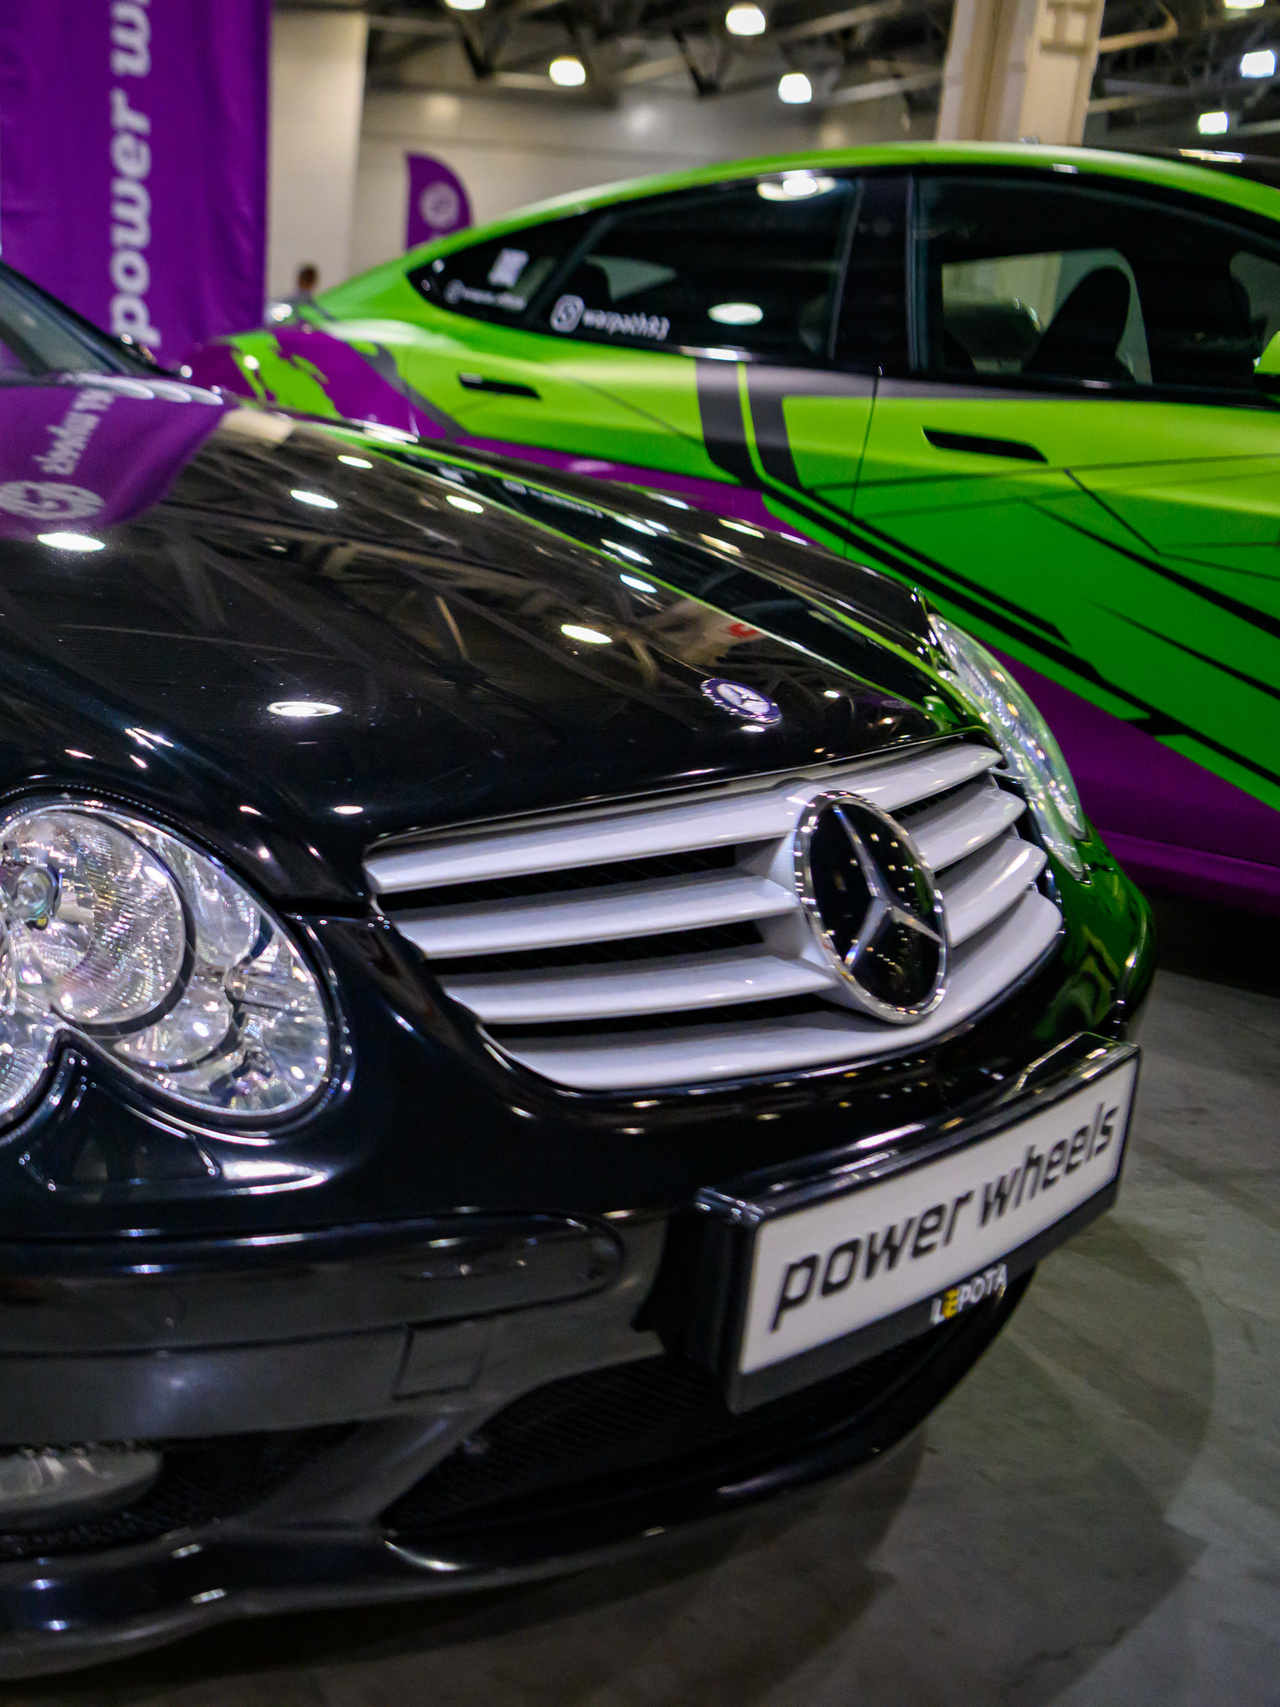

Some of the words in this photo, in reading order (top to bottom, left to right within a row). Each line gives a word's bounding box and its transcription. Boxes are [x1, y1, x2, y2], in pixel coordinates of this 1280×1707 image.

[111, 87, 160, 346] power
[771, 1191, 973, 1331] power
[979, 1102, 1119, 1226] wheels
[930, 1263, 1006, 1325] LEPOTA
